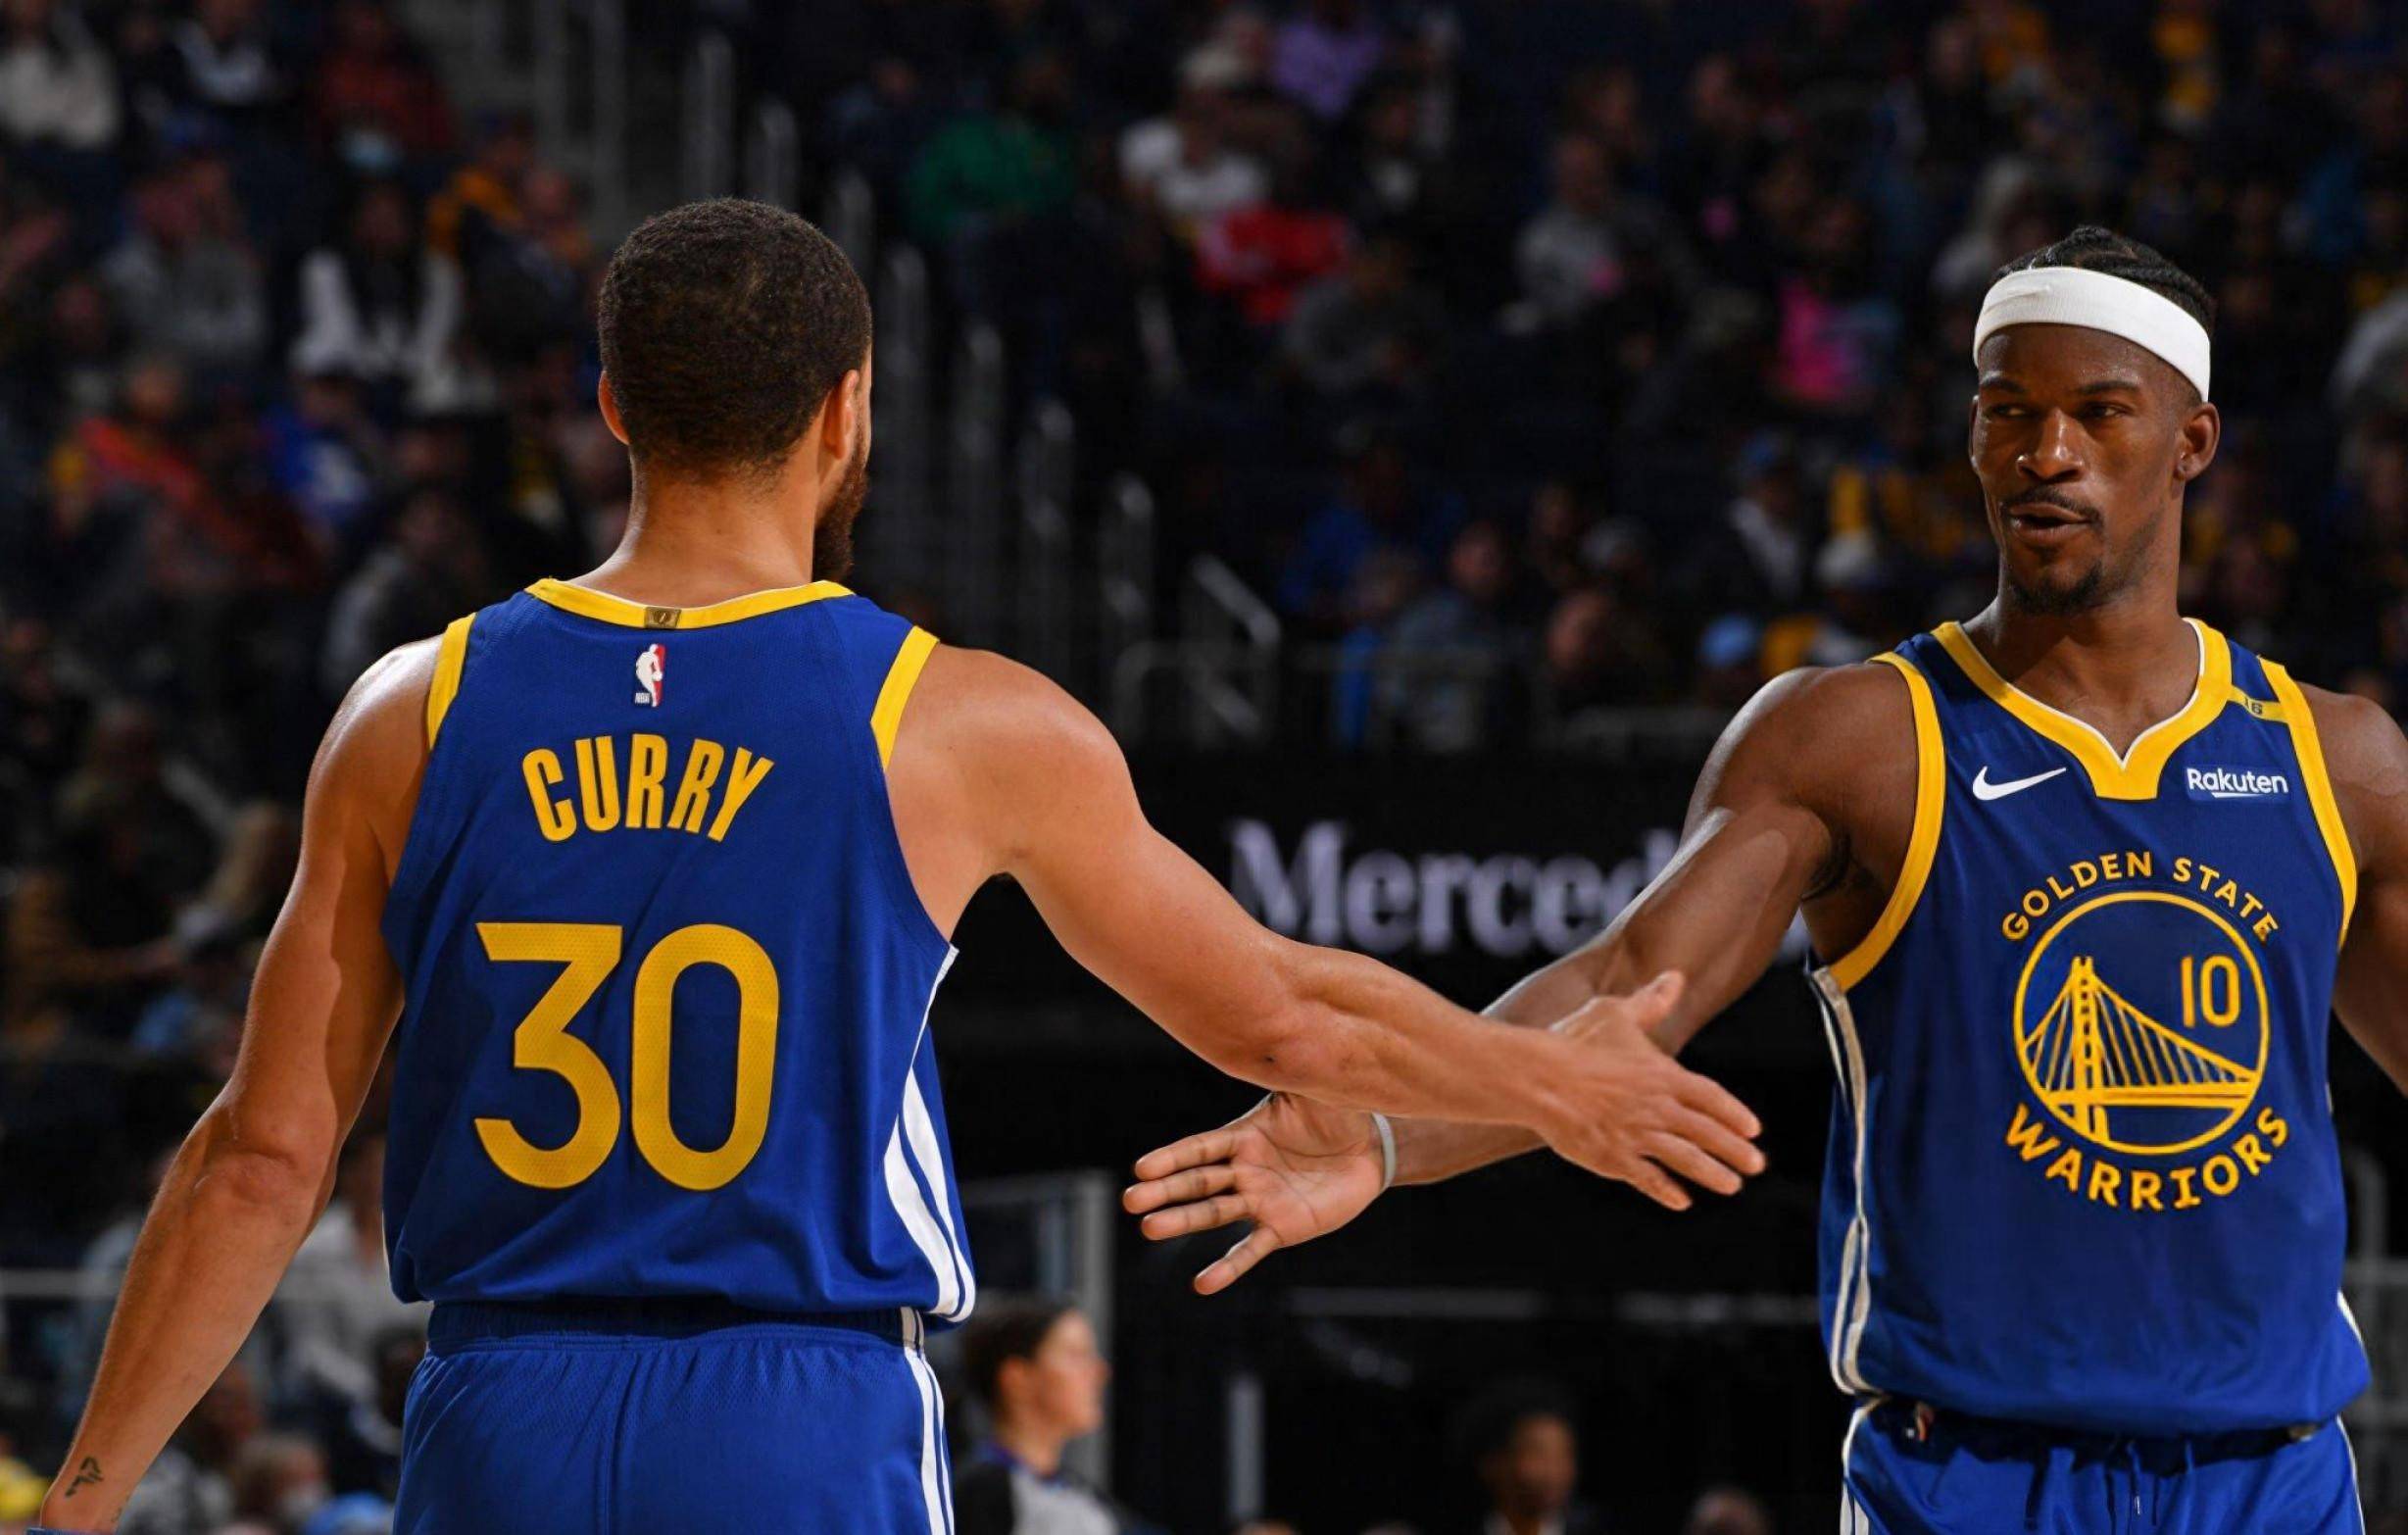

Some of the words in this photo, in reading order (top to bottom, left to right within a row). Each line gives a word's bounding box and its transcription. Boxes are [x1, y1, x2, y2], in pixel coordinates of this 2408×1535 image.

[522, 733, 774, 842] CURRY
[2187, 768, 2288, 793] Rakuten
[2002, 851, 2152, 941] GOLDEN
[2173, 858, 2279, 942] STATE
[2181, 955, 2240, 1028] 10
[474, 922, 779, 1191] 30
[2005, 1103, 2288, 1212] WARRIORS
